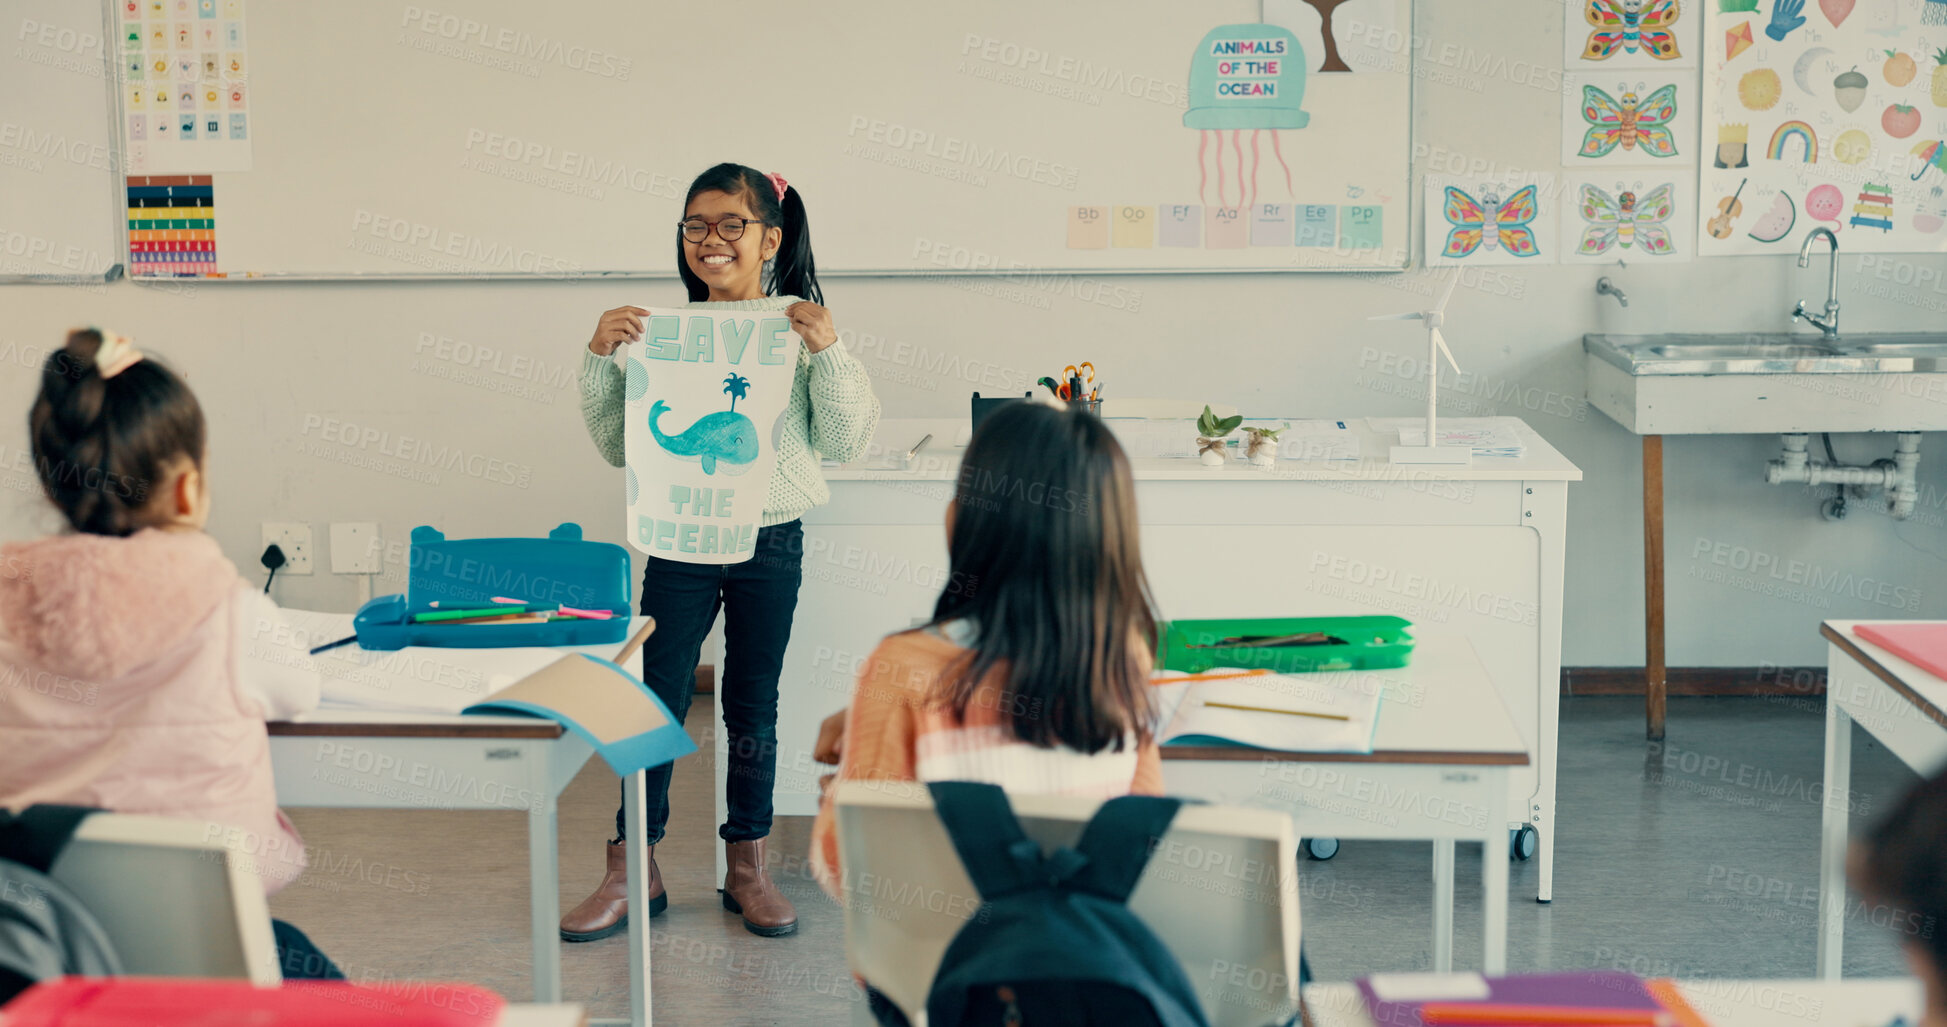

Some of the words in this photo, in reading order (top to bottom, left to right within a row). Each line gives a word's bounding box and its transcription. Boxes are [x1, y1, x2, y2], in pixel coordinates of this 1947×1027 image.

[1213, 40, 1285, 54] ANIMALS
[1219, 61, 1241, 75] OF
[1245, 61, 1278, 75] THE
[1218, 83, 1275, 95] OCEAN
[1077, 207, 1100, 220] Bb
[1122, 207, 1146, 220] Oo
[1173, 205, 1190, 218] Ff
[1215, 207, 1239, 220] Aa
[1263, 203, 1281, 217] Rr
[1305, 204, 1327, 218] Ee
[1351, 206, 1374, 222] Pp
[645, 315, 791, 366] SAVE
[669, 484, 735, 518] THE
[637, 514, 754, 555] OCEANS
